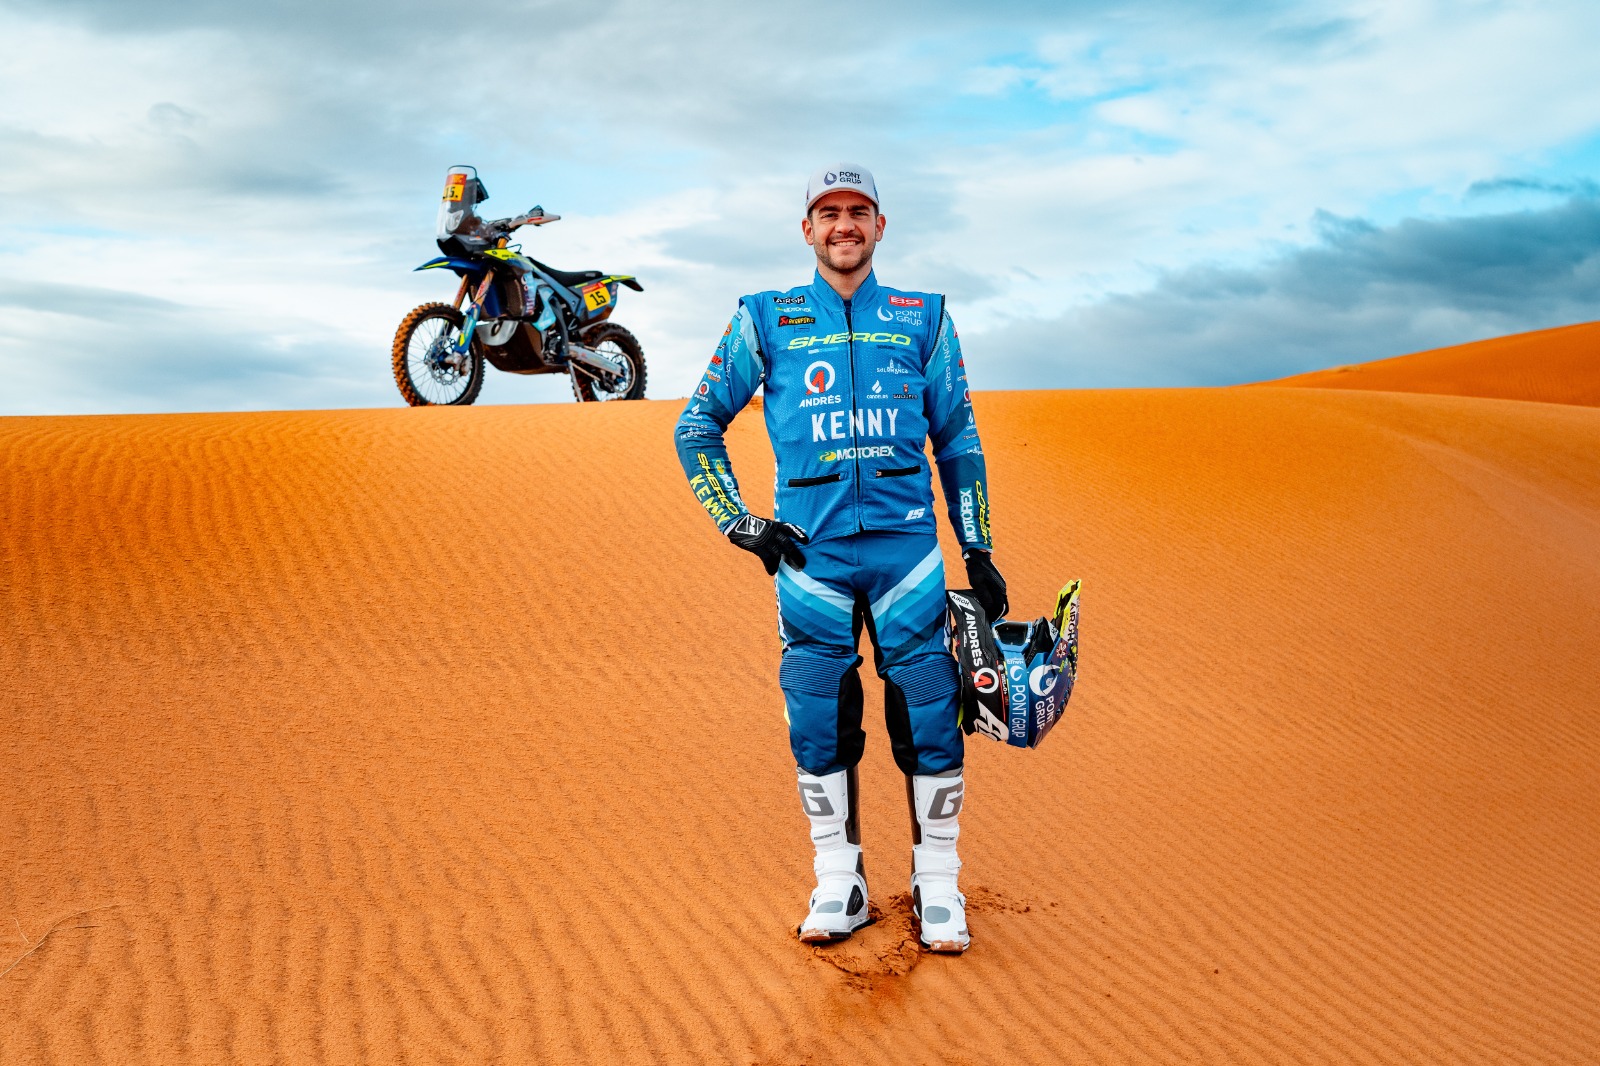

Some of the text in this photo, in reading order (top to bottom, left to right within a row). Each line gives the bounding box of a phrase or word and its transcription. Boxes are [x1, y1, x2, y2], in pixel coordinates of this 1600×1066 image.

[839, 171, 860, 179] PONT
[589, 291, 607, 307] 15
[895, 310, 922, 319] PONT
[896, 315, 923, 326] GRUP
[787, 332, 911, 350] SHERCO
[942, 336, 951, 364] PONT
[798, 395, 841, 408] ANDRÉS
[811, 408, 899, 442] KENNY
[836, 446, 895, 461] MOTOREX
[697, 452, 739, 515] SHERCO
[689, 473, 731, 527] KENNY
[960, 489, 978, 543] MOTOREX
[951, 594, 969, 606] AIROH
[964, 611, 984, 667] ANDRÉS
[1011, 684, 1027, 717] PONT
[1045, 695, 1055, 723] PONT
[1035, 700, 1045, 730] GRUP
[1011, 717, 1027, 738] GRUP
